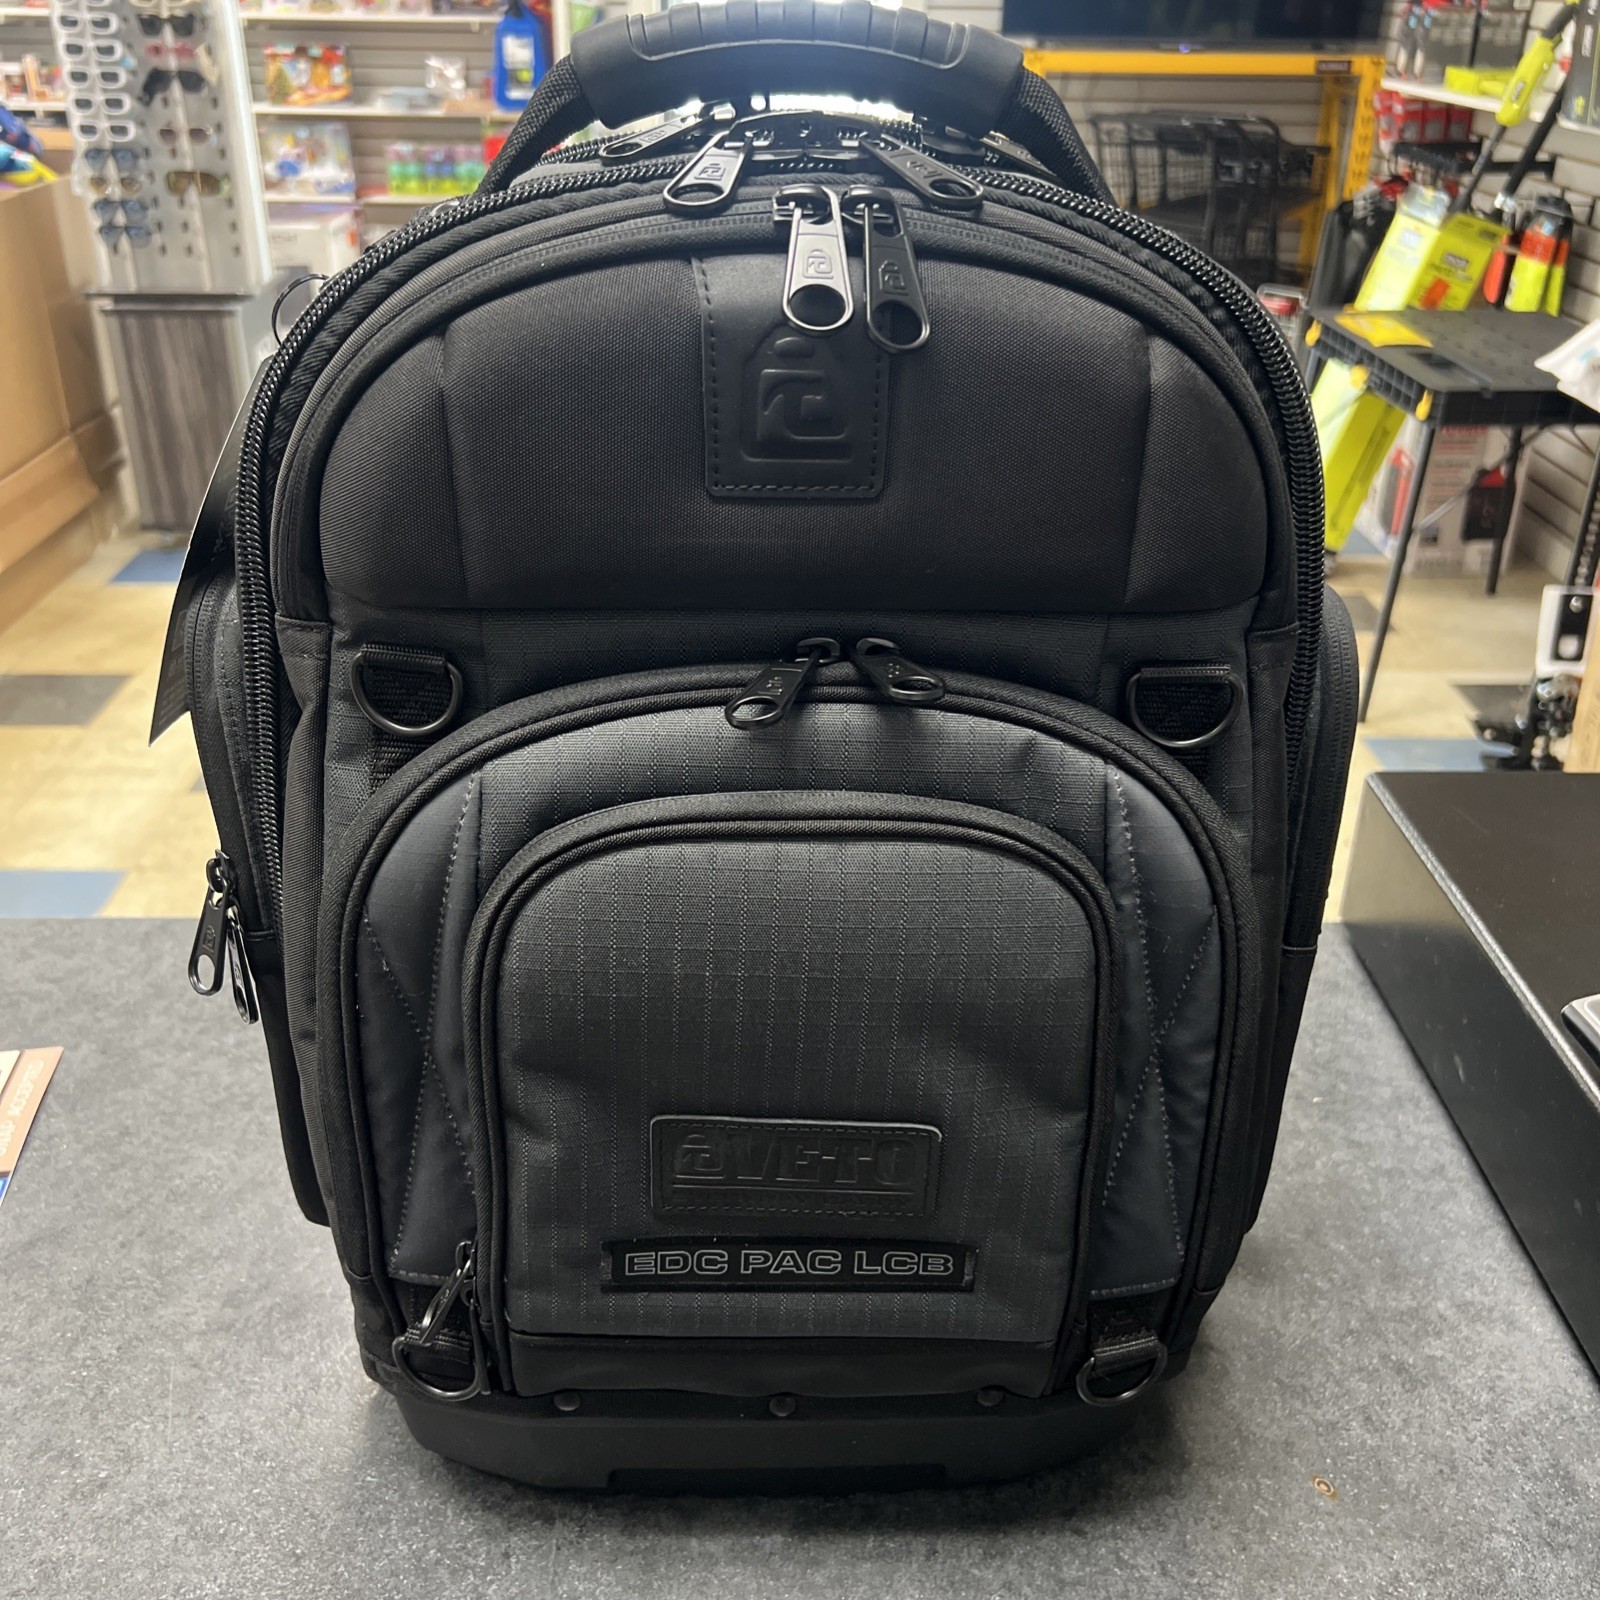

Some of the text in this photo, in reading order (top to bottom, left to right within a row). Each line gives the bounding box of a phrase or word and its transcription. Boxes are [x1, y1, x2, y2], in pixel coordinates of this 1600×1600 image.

[726, 1133, 919, 1186] VETO
[624, 1249, 955, 1276] EDC PAC LCB
